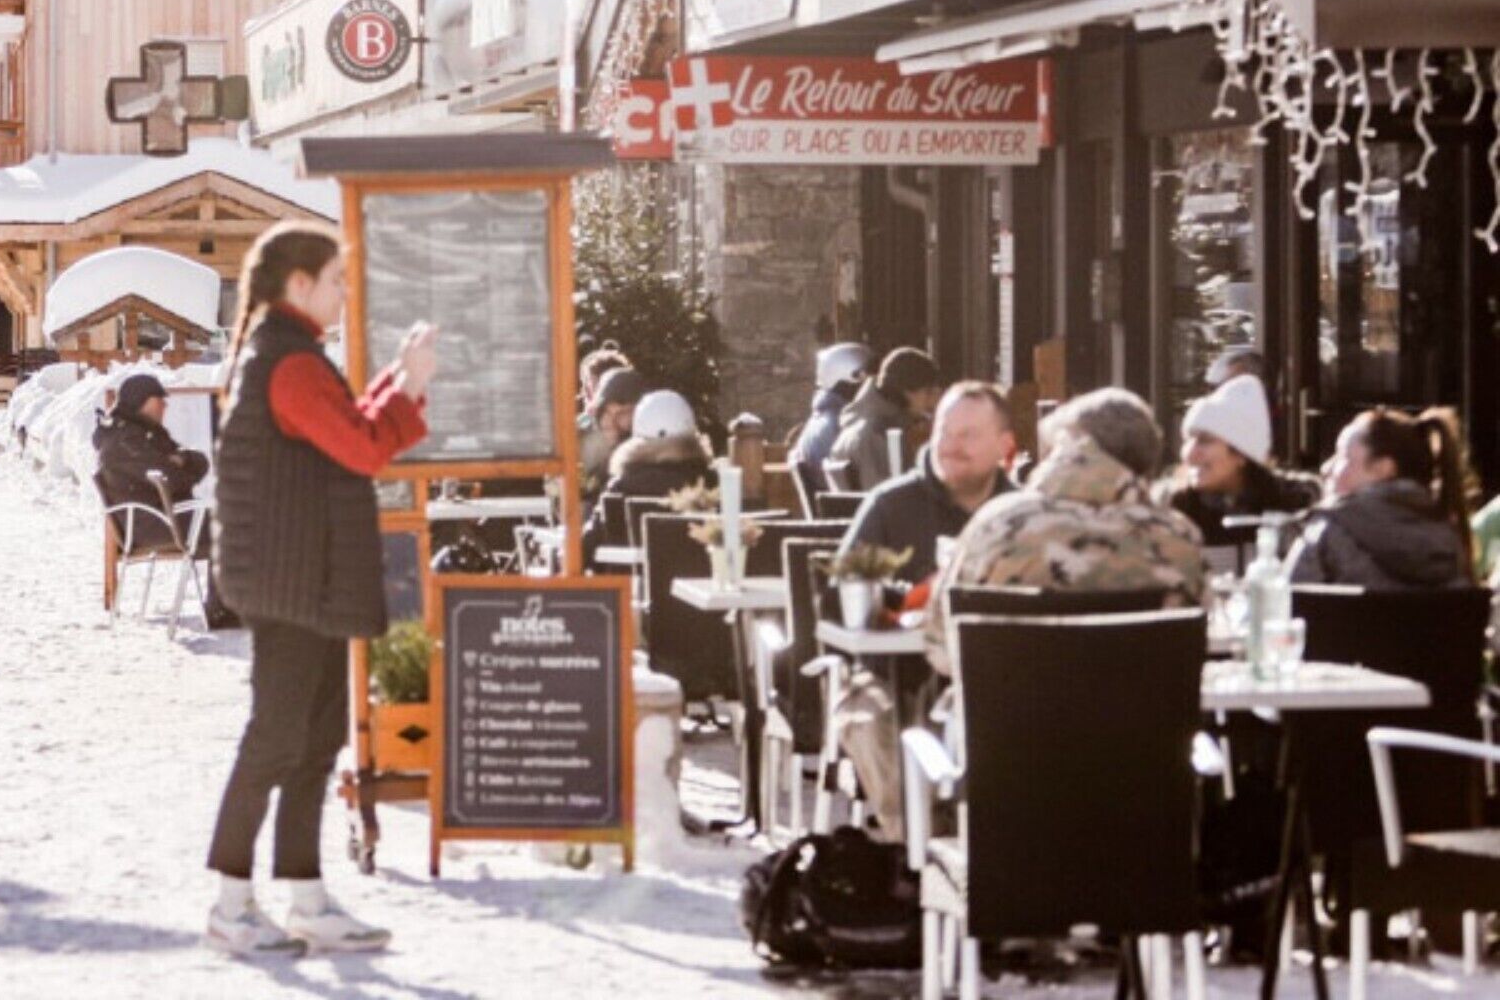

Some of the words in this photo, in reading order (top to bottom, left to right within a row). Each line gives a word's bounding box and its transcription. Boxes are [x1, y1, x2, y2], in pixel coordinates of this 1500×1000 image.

[356, 19, 386, 60] B
[731, 65, 773, 115] Le
[780, 65, 886, 118] Retour
[887, 78, 919, 113] du
[729, 128, 770, 154] SUR
[783, 128, 852, 154] PLACE
[861, 128, 891, 153] OU
[916, 128, 1027, 157] EMPORTER
